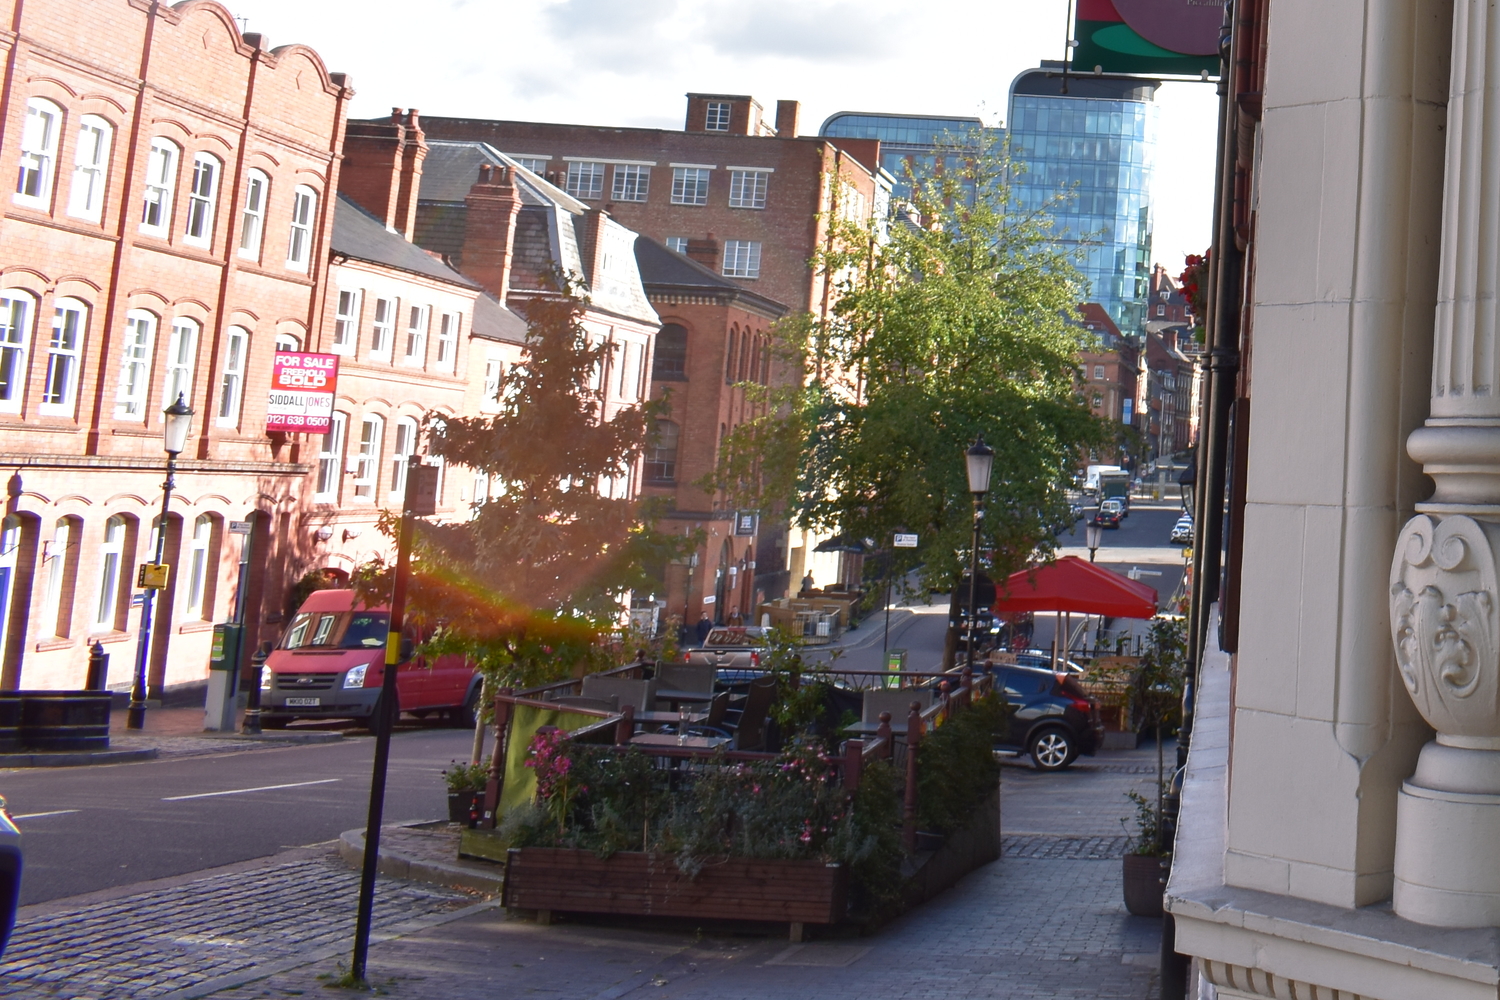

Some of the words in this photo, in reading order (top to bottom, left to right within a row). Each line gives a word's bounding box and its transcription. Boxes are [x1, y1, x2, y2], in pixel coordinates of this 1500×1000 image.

[275, 355, 300, 367] FOR
[303, 356, 334, 369] SALE
[281, 367, 326, 377] FREEHOLD
[278, 375, 327, 387] SOLD
[269, 394, 304, 406] SIDDALL
[303, 396, 331, 414] JONES
[266, 414, 285, 424] 0121
[287, 415, 304, 425] 638
[306, 417, 329, 426] 0500
